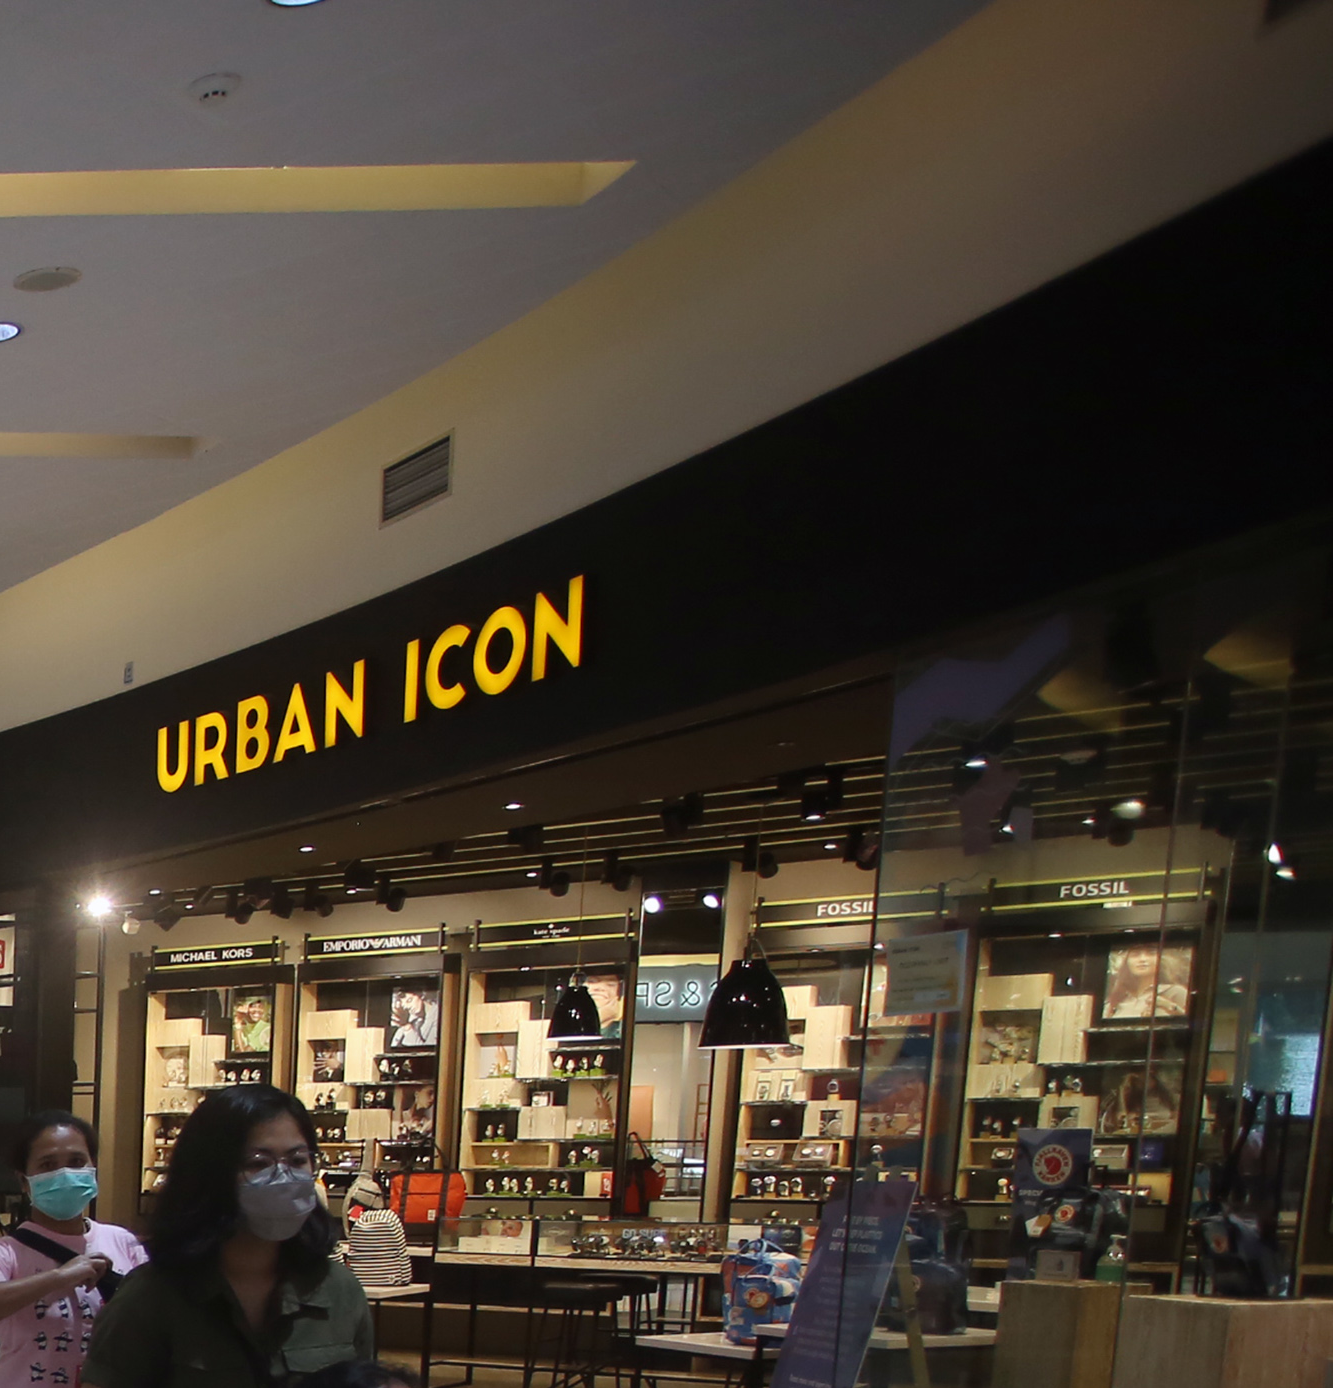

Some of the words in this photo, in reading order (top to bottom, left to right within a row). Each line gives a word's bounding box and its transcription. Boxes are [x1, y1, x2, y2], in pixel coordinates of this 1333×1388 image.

[156, 658, 365, 793] URBAN
[403, 574, 584, 723] ICON
[1059, 880, 1130, 898] FOSSIL
[817, 900, 874, 917] FOSSIL
[323, 938, 370, 952] EMPORIO
[382, 934, 422, 948] ARMANI
[170, 950, 218, 963] MICHAEL
[222, 948, 254, 959] KORS
